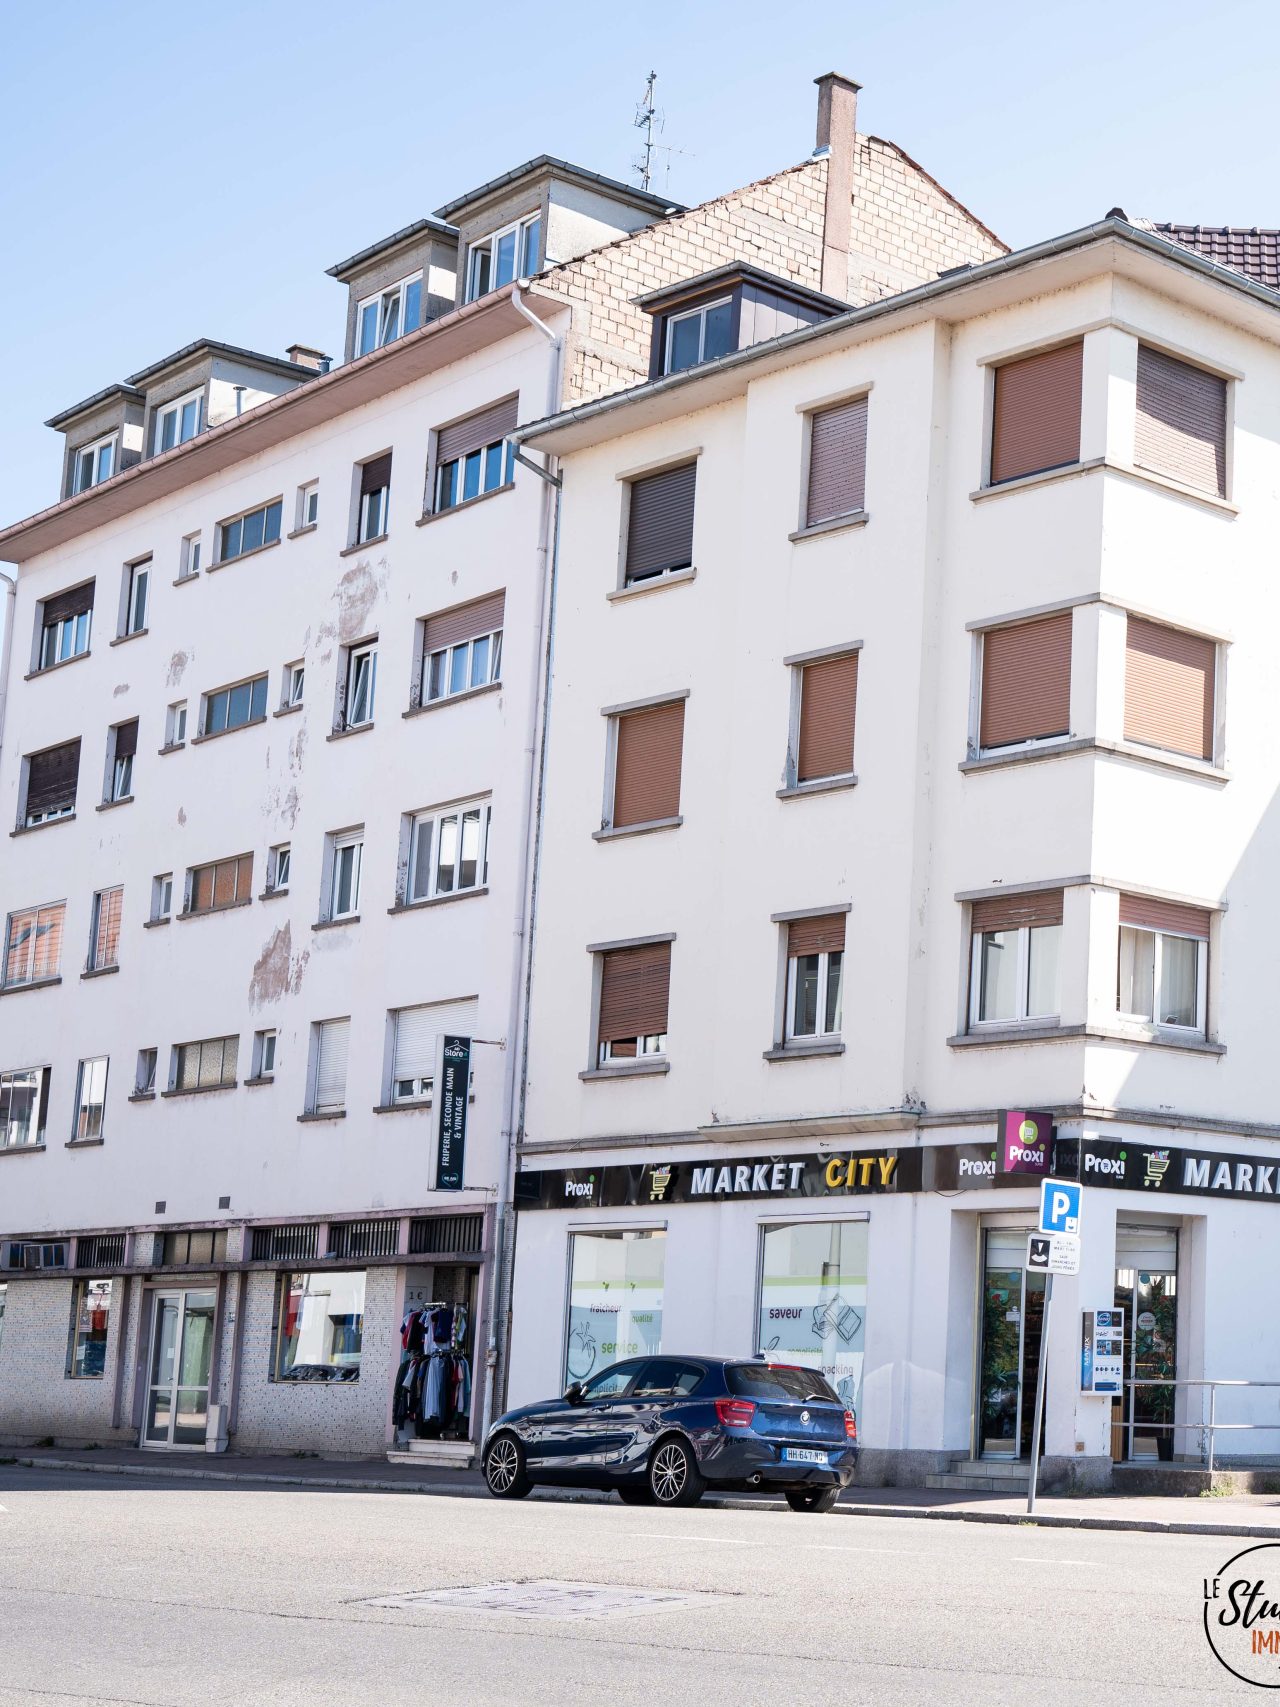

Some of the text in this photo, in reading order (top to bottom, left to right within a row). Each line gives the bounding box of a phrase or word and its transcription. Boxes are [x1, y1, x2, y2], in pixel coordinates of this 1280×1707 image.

[445, 1049, 464, 1057] Store
[446, 1068, 454, 1090] MAIN
[444, 1092, 453, 1126] SECONDE
[454, 1096, 464, 1130] VINTAGE
[442, 1130, 452, 1166] FRIPERIE,
[1009, 1144, 1045, 1162] Proxi
[959, 1152, 996, 1176] Proxi
[1084, 1151, 1127, 1175] Proxi
[565, 1174, 596, 1197] Proxi
[690, 1157, 899, 1194] MARKET CITY
[1052, 1191, 1070, 1223] P
[590, 1303, 622, 1312] fraîcheur
[631, 1314, 653, 1324] qualité
[769, 1308, 802, 1319] saveur
[818, 1364, 854, 1375] snacking
